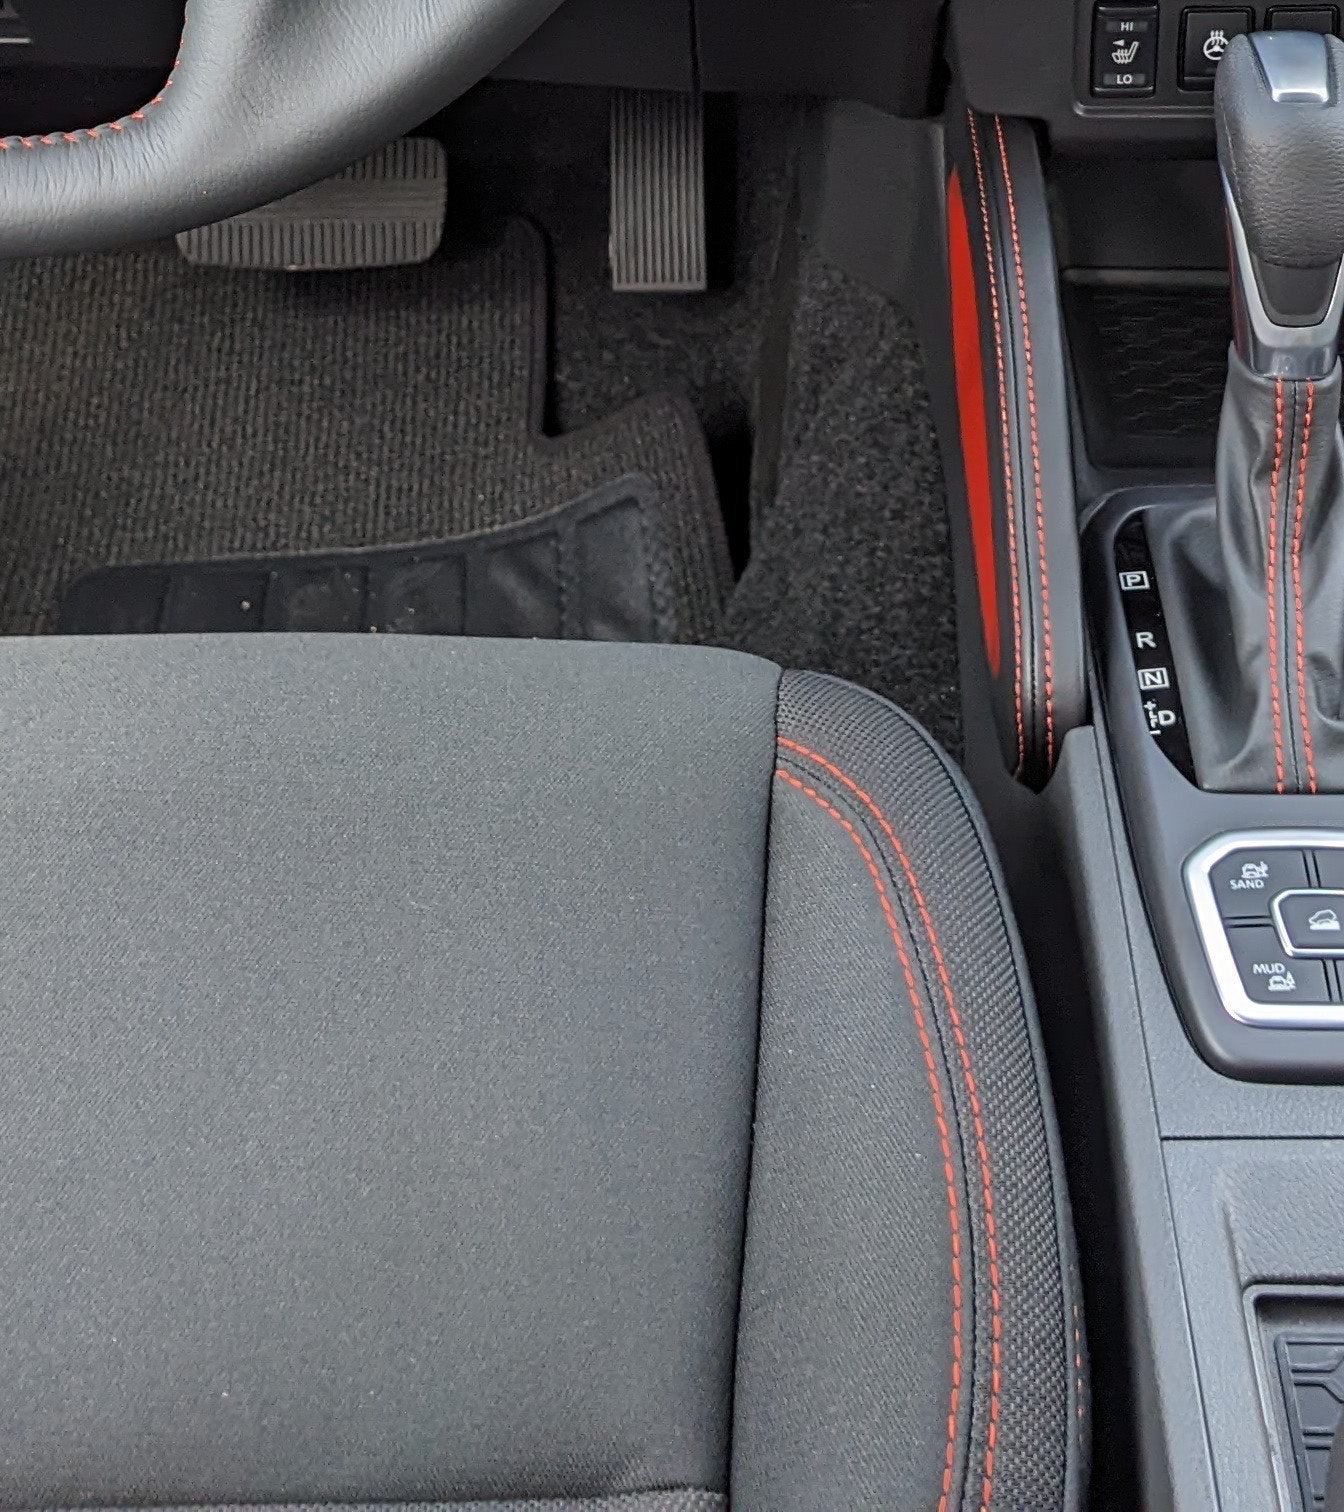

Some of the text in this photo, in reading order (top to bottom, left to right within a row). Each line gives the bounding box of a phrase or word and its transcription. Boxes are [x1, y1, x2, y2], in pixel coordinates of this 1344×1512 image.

[1120, 21, 1135, 32] HI
[1116, 74, 1133, 86] LO
[1135, 631, 1157, 649] R
[1158, 709, 1177, 727] D
[1229, 879, 1265, 890] SAND
[1252, 963, 1287, 974] MUD
